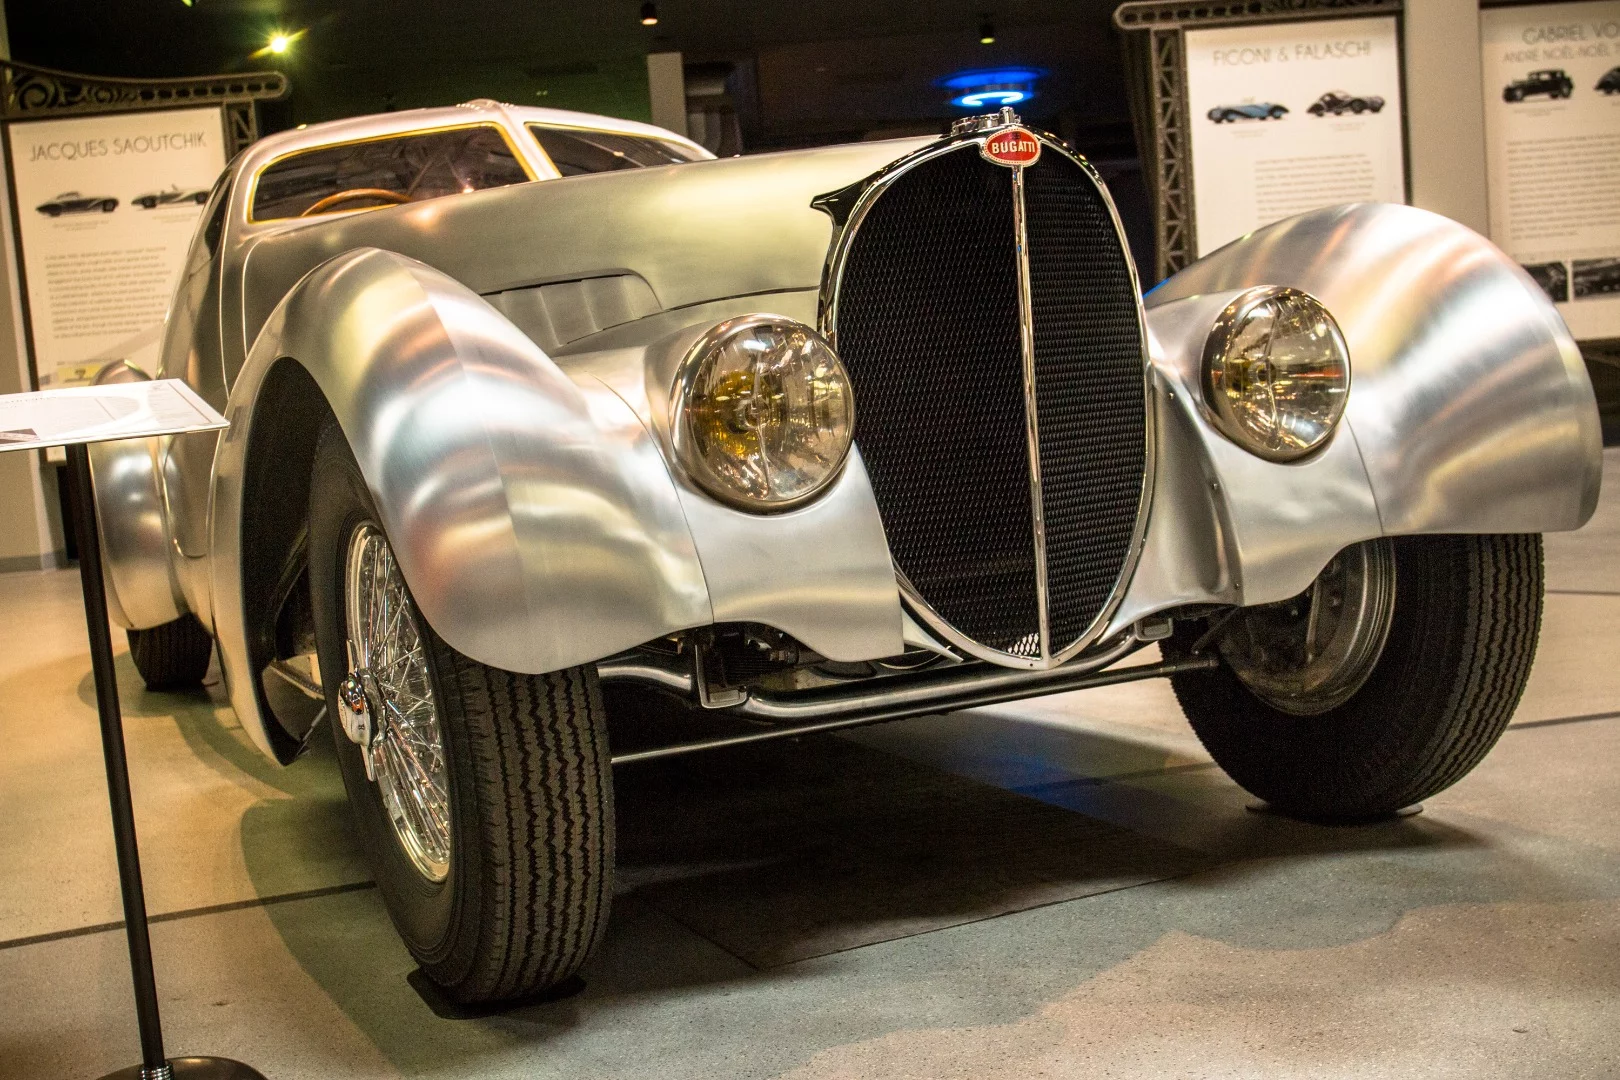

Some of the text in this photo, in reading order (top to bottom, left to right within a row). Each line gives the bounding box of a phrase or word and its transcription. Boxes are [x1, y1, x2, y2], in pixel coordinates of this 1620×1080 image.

[1522, 24, 1588, 45] GABRIEL
[1213, 40, 1371, 66] FIGONI & FALASCHI
[30, 132, 207, 162] JACQUES SAOUTCHIK
[991, 140, 1036, 154] BUGATTI
